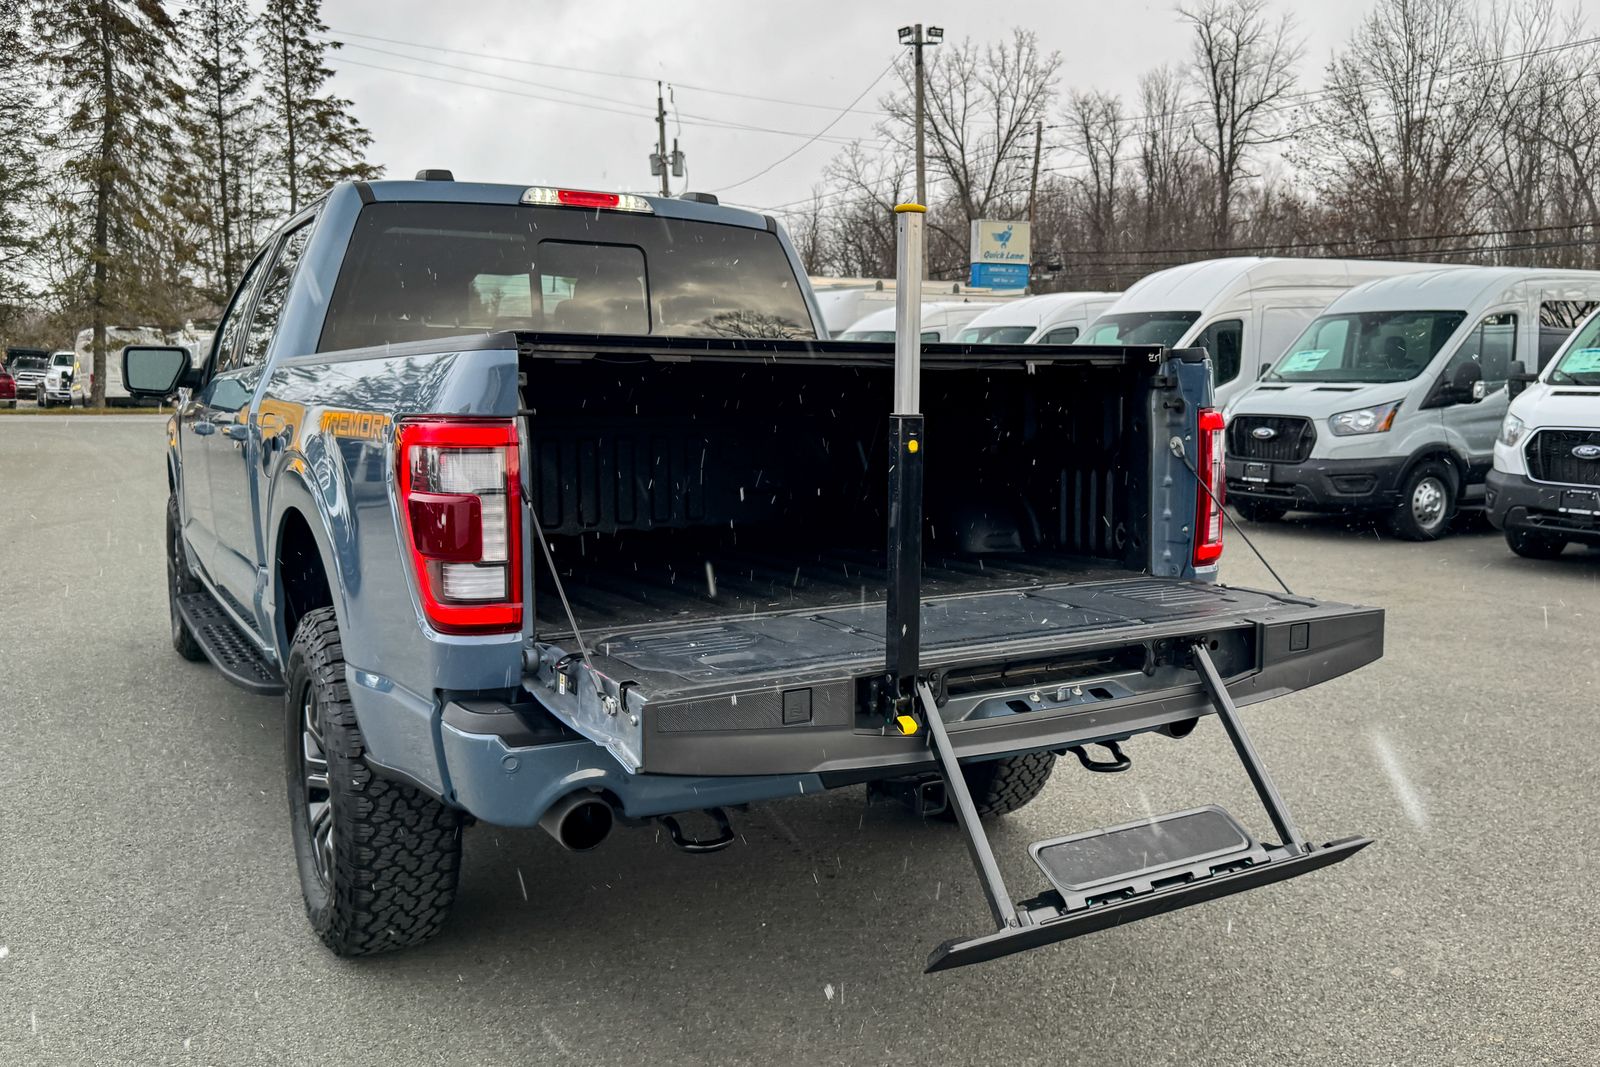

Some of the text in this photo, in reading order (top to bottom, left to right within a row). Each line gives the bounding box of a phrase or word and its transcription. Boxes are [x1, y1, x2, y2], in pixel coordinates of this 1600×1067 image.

[984, 250, 1024, 259] Quick Lane
[321, 411, 384, 439] TREMOR
